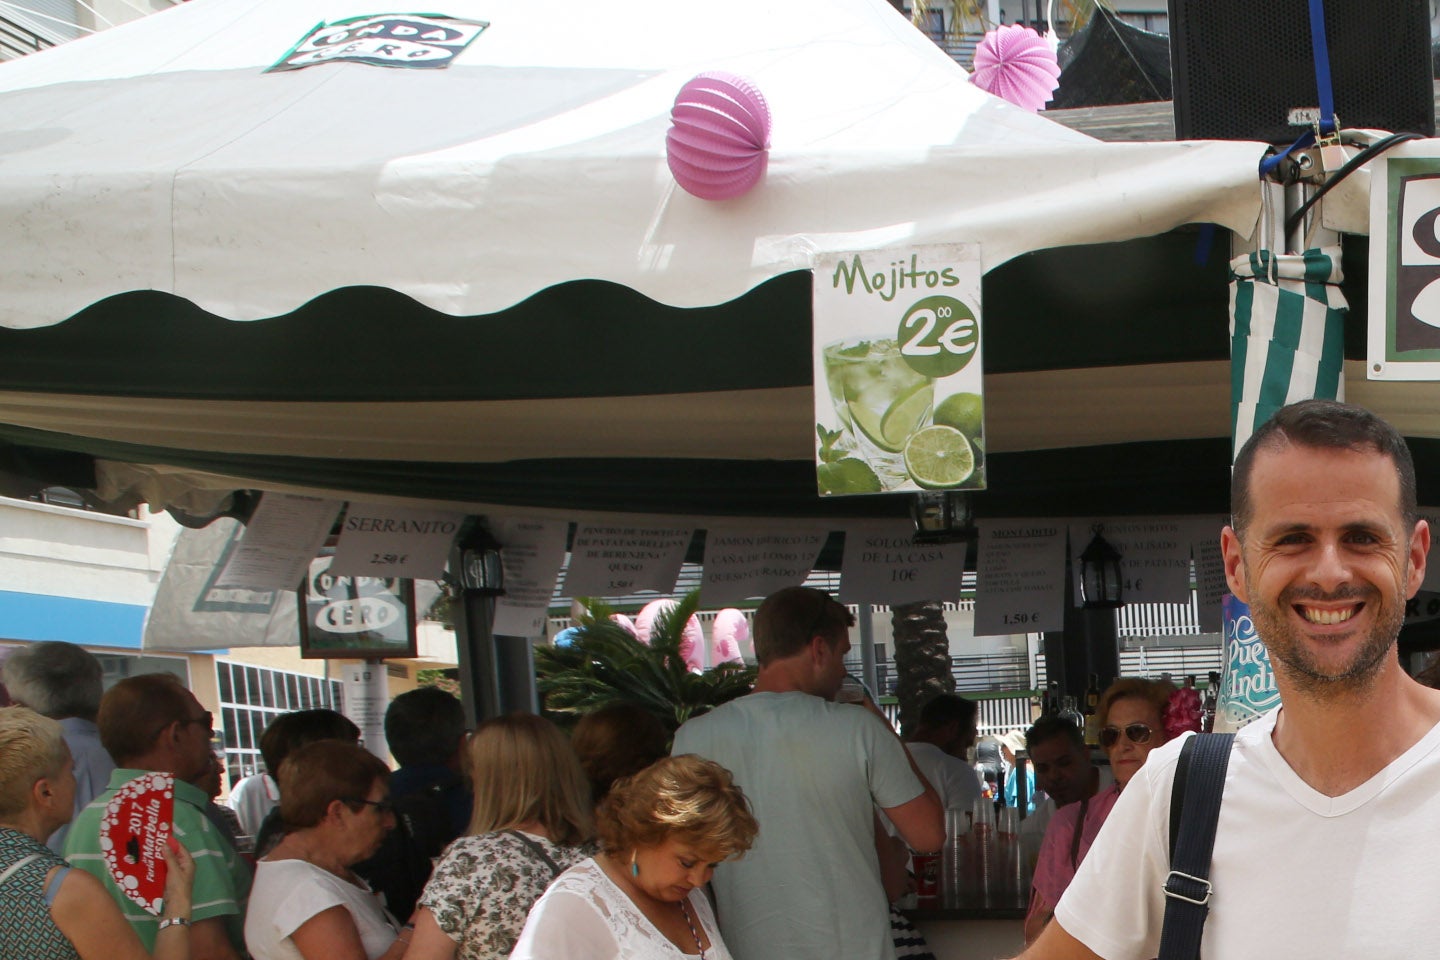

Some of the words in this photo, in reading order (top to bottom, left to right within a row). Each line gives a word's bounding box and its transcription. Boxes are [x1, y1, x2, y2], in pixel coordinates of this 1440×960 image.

[326, 24, 447, 44] ONDA
[833, 253, 960, 302] Mojitos
[346, 516, 456, 534] SERRANITO
[862, 551, 881, 562] DE
[885, 551, 903, 563] LA
[908, 551, 944, 563] CASA
[326, 605, 388, 626] CERO
[128, 801, 144, 835] 2017
[142, 798, 162, 859] Marbella
